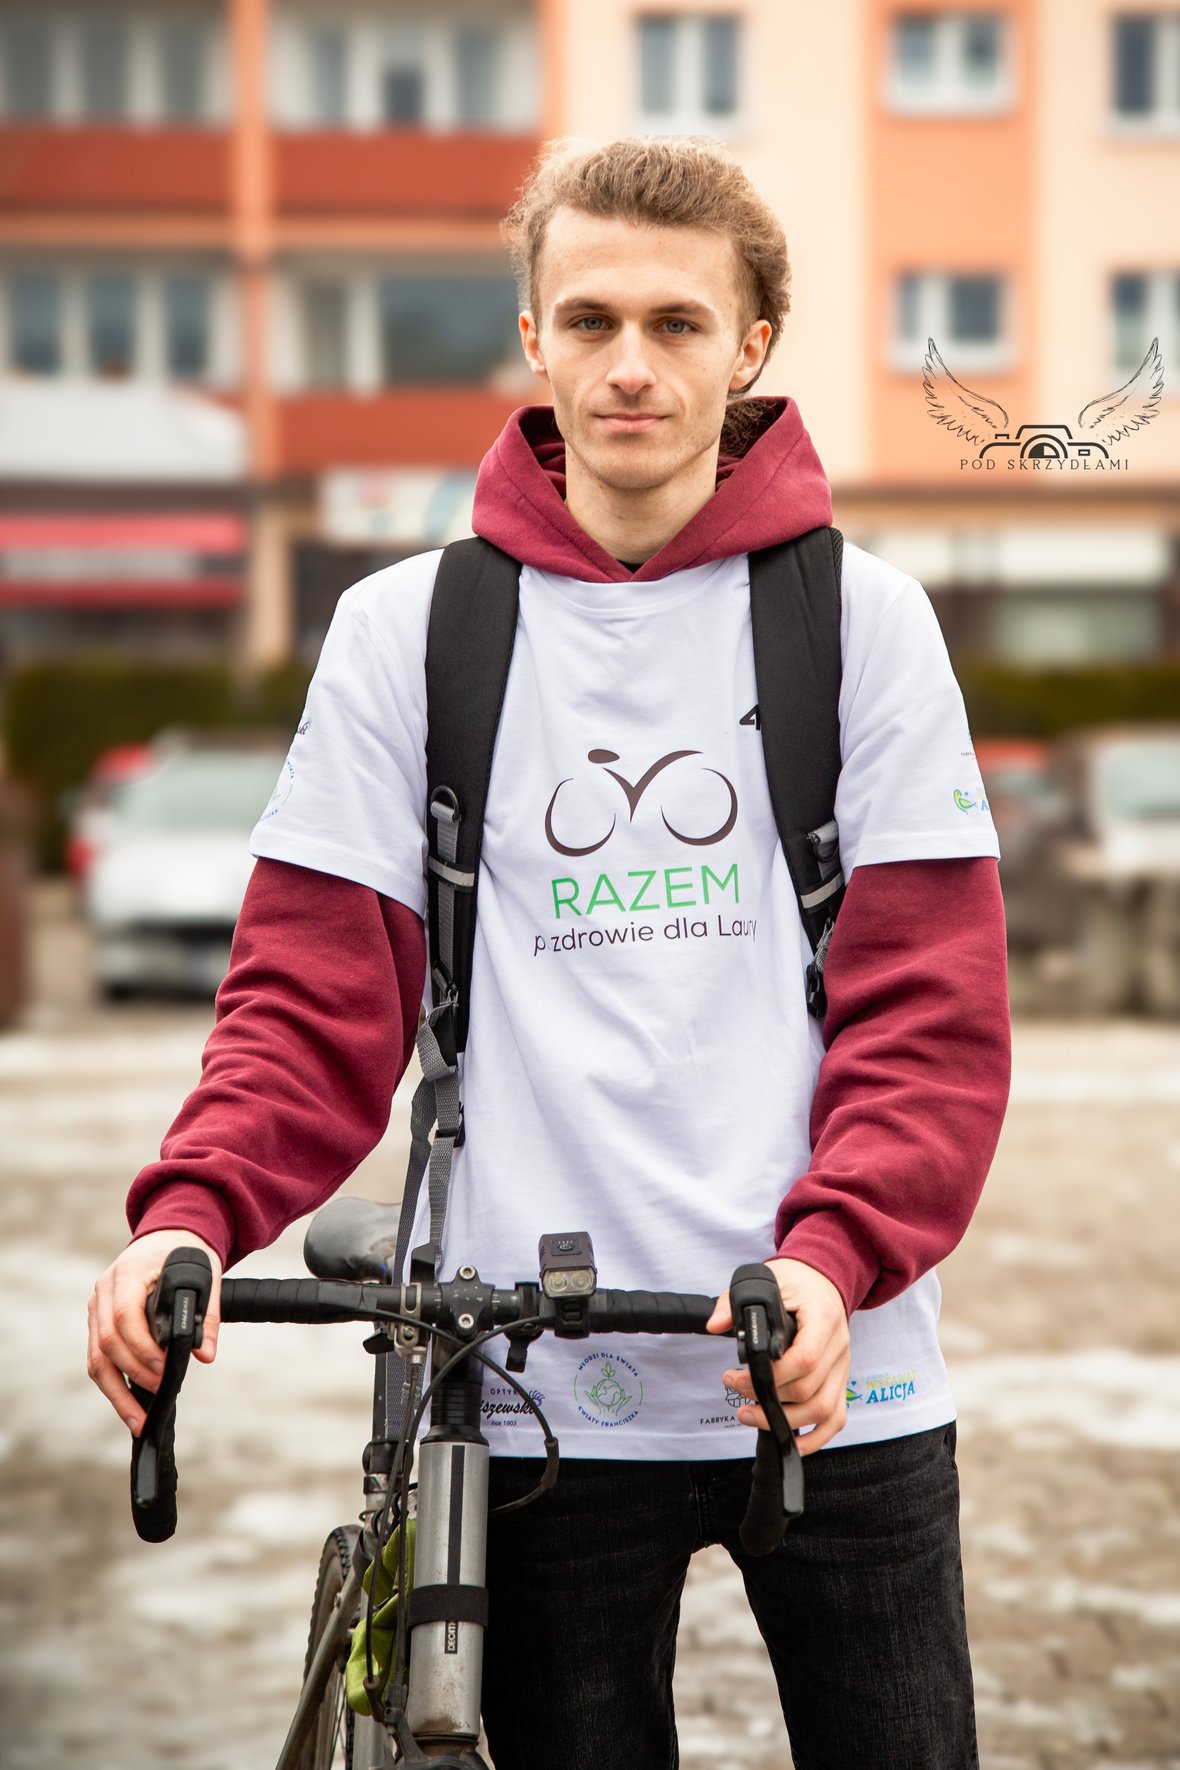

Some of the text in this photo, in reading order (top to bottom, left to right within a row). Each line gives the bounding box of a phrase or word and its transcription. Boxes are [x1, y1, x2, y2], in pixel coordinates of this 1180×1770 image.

[551, 863, 740, 919] RAZEM
[534, 935, 551, 957] p
[550, 922, 654, 952] zdrowie
[663, 916, 708, 940] dla
[601, 1352, 614, 1360] DLA
[866, 1380, 916, 1405] ALICJA
[578, 1405, 639, 1428] KWIATY FRANCISZKA
[700, 1415, 736, 1425] FABRYKA
